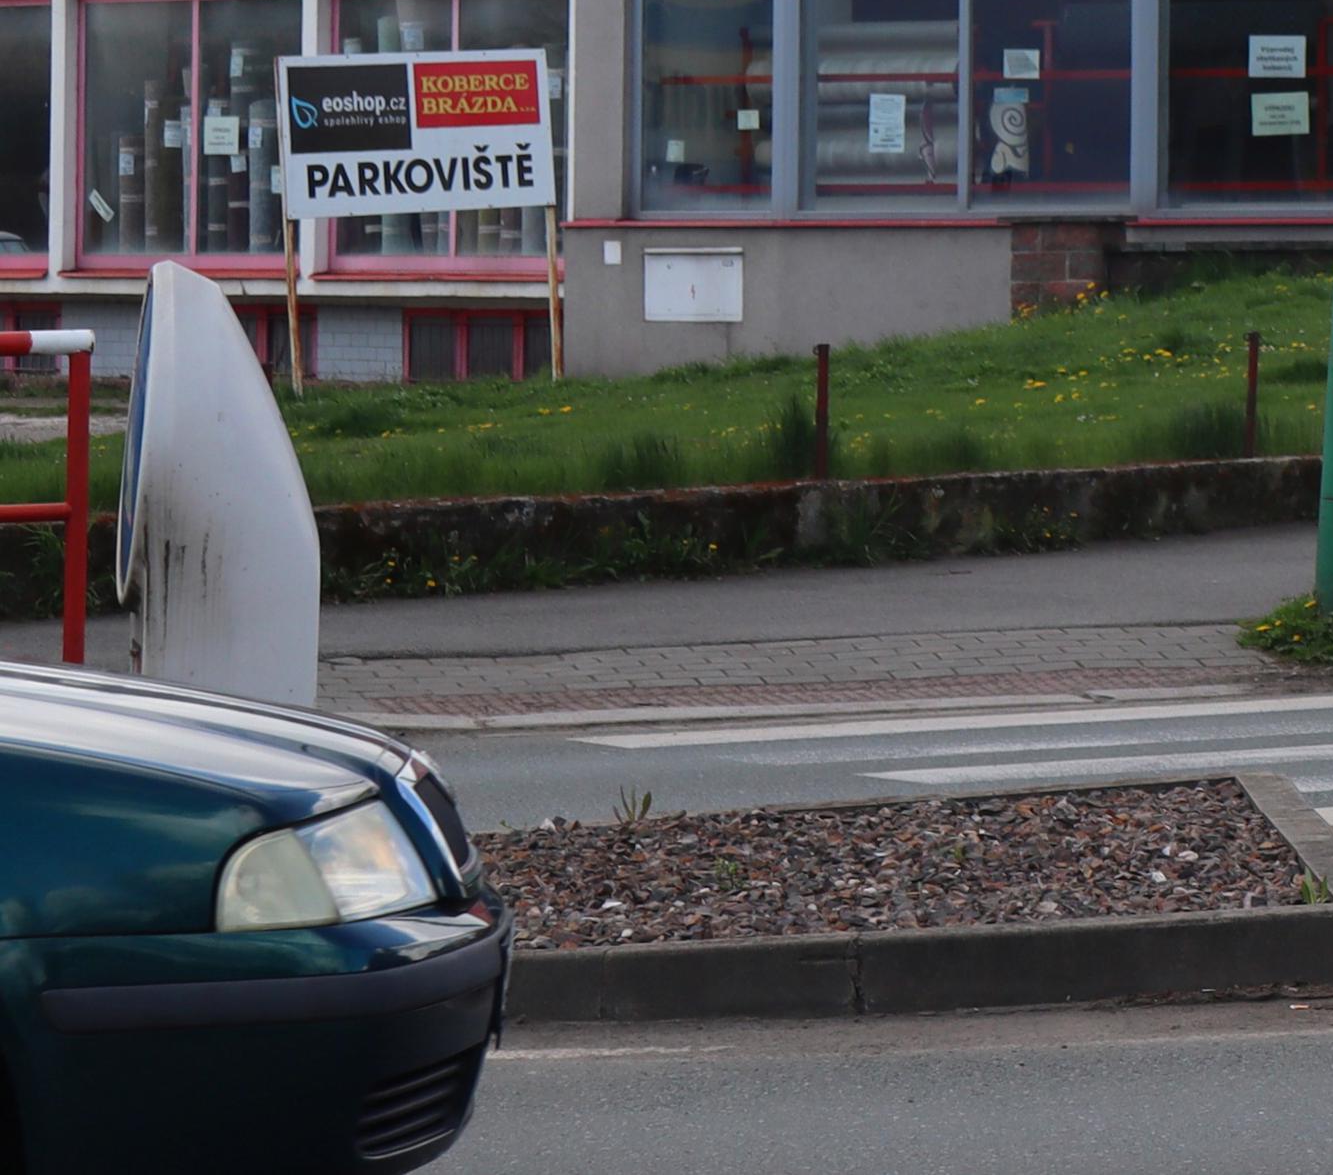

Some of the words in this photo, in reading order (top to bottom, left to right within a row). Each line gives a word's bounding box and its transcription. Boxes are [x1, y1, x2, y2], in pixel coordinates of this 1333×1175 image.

[421, 73, 529, 93] KOBERCE
[322, 90, 406, 115] eoshop.cz
[422, 93, 518, 115] BRÁZDA
[324, 113, 374, 127] spolehlivý
[378, 114, 406, 126] eshop
[306, 143, 535, 199] PARKOVIŠTĚ
